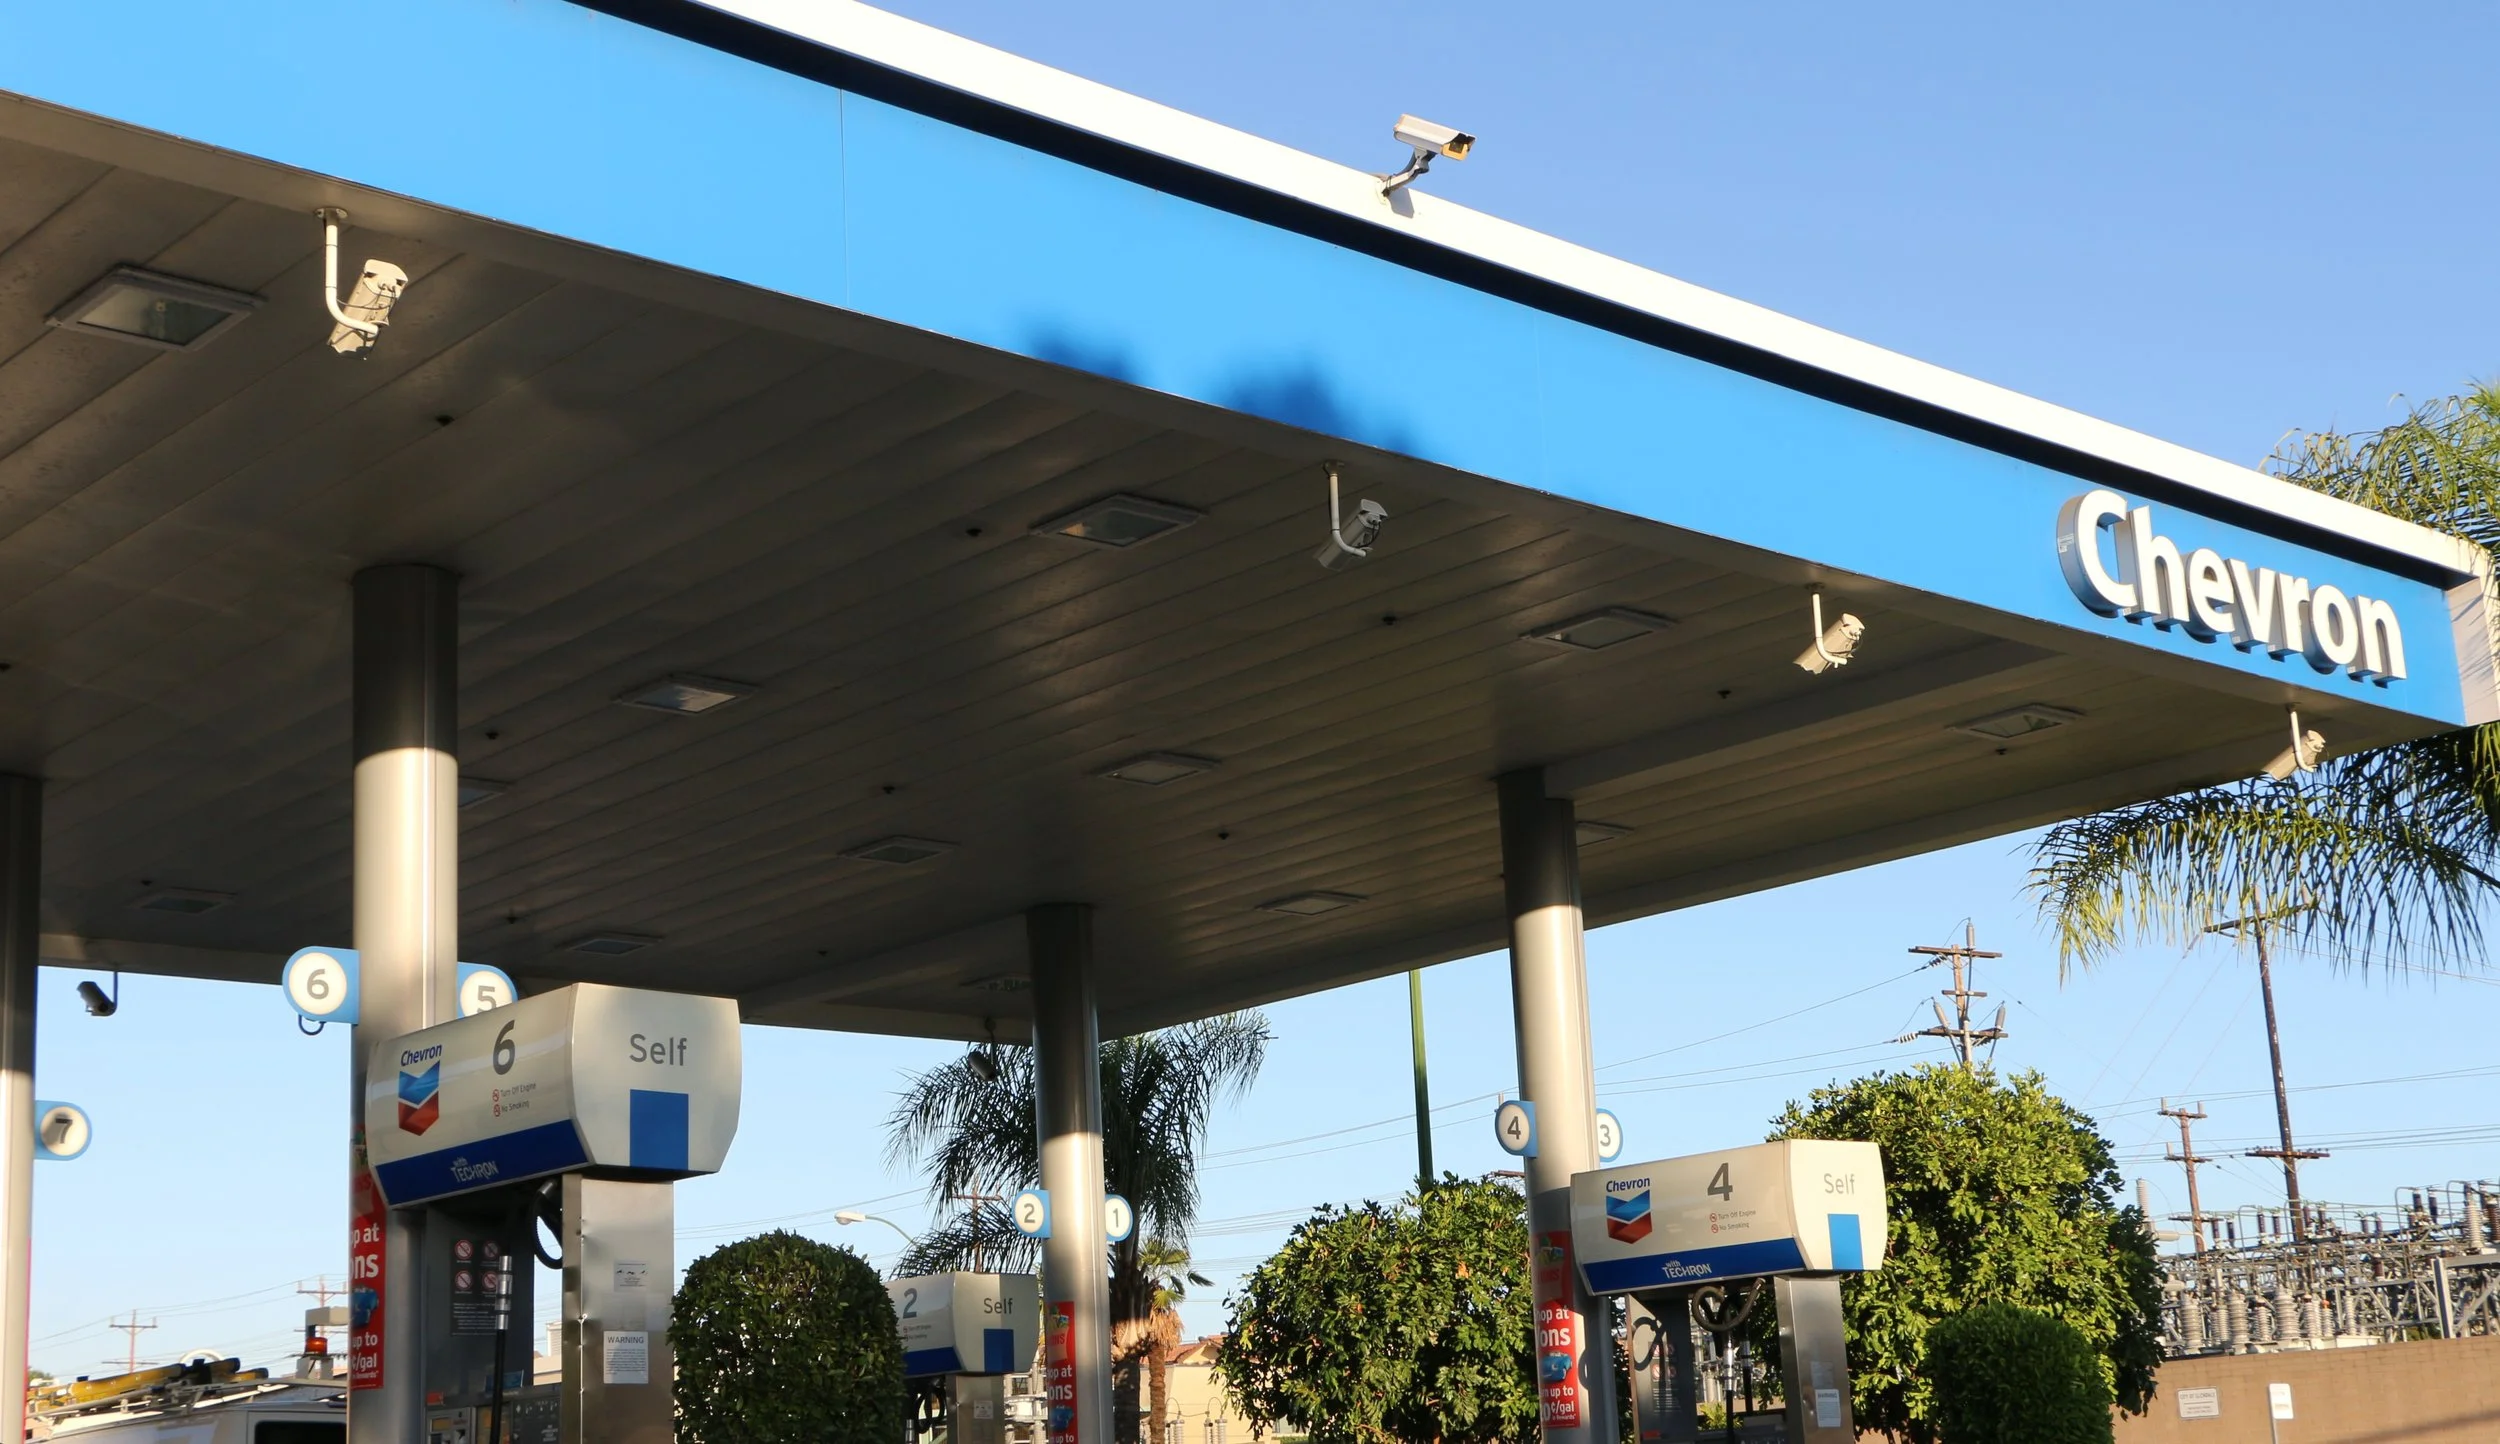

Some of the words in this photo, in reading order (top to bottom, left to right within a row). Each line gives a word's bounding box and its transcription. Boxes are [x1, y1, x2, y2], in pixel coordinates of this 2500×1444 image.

[2058, 488, 2407, 683] Chevron
[306, 968, 330, 1000] 6
[476, 984, 497, 1014] 5
[400, 1044, 443, 1067] Chevron
[492, 1018, 516, 1076] 6
[629, 1033, 687, 1067] Self
[55, 1118, 73, 1144] 7
[1507, 1116, 1521, 1140] 4
[1599, 1124, 1611, 1147] 3
[451, 1161, 499, 1183] TECHRON
[1707, 1162, 1733, 1201] 4
[1606, 1177, 1651, 1193] Chevron
[1823, 1173, 1855, 1194] Self
[1023, 1203, 1036, 1223] 2
[1112, 1208, 1119, 1228] 1
[363, 1222, 380, 1243] at
[1661, 1263, 1712, 1280] TECHRON
[1665, 1260, 1681, 1268] with
[903, 1287, 918, 1319] 2
[983, 1297, 1013, 1315] Self
[1555, 1305, 1570, 1320] at
[364, 1331, 378, 1347] to
[607, 1336, 645, 1344] WARNING
[1061, 1364, 1072, 1377] at
[1550, 1388, 1561, 1399] up
[1562, 1385, 1574, 1397] to
[1065, 1432, 1074, 1444] to
